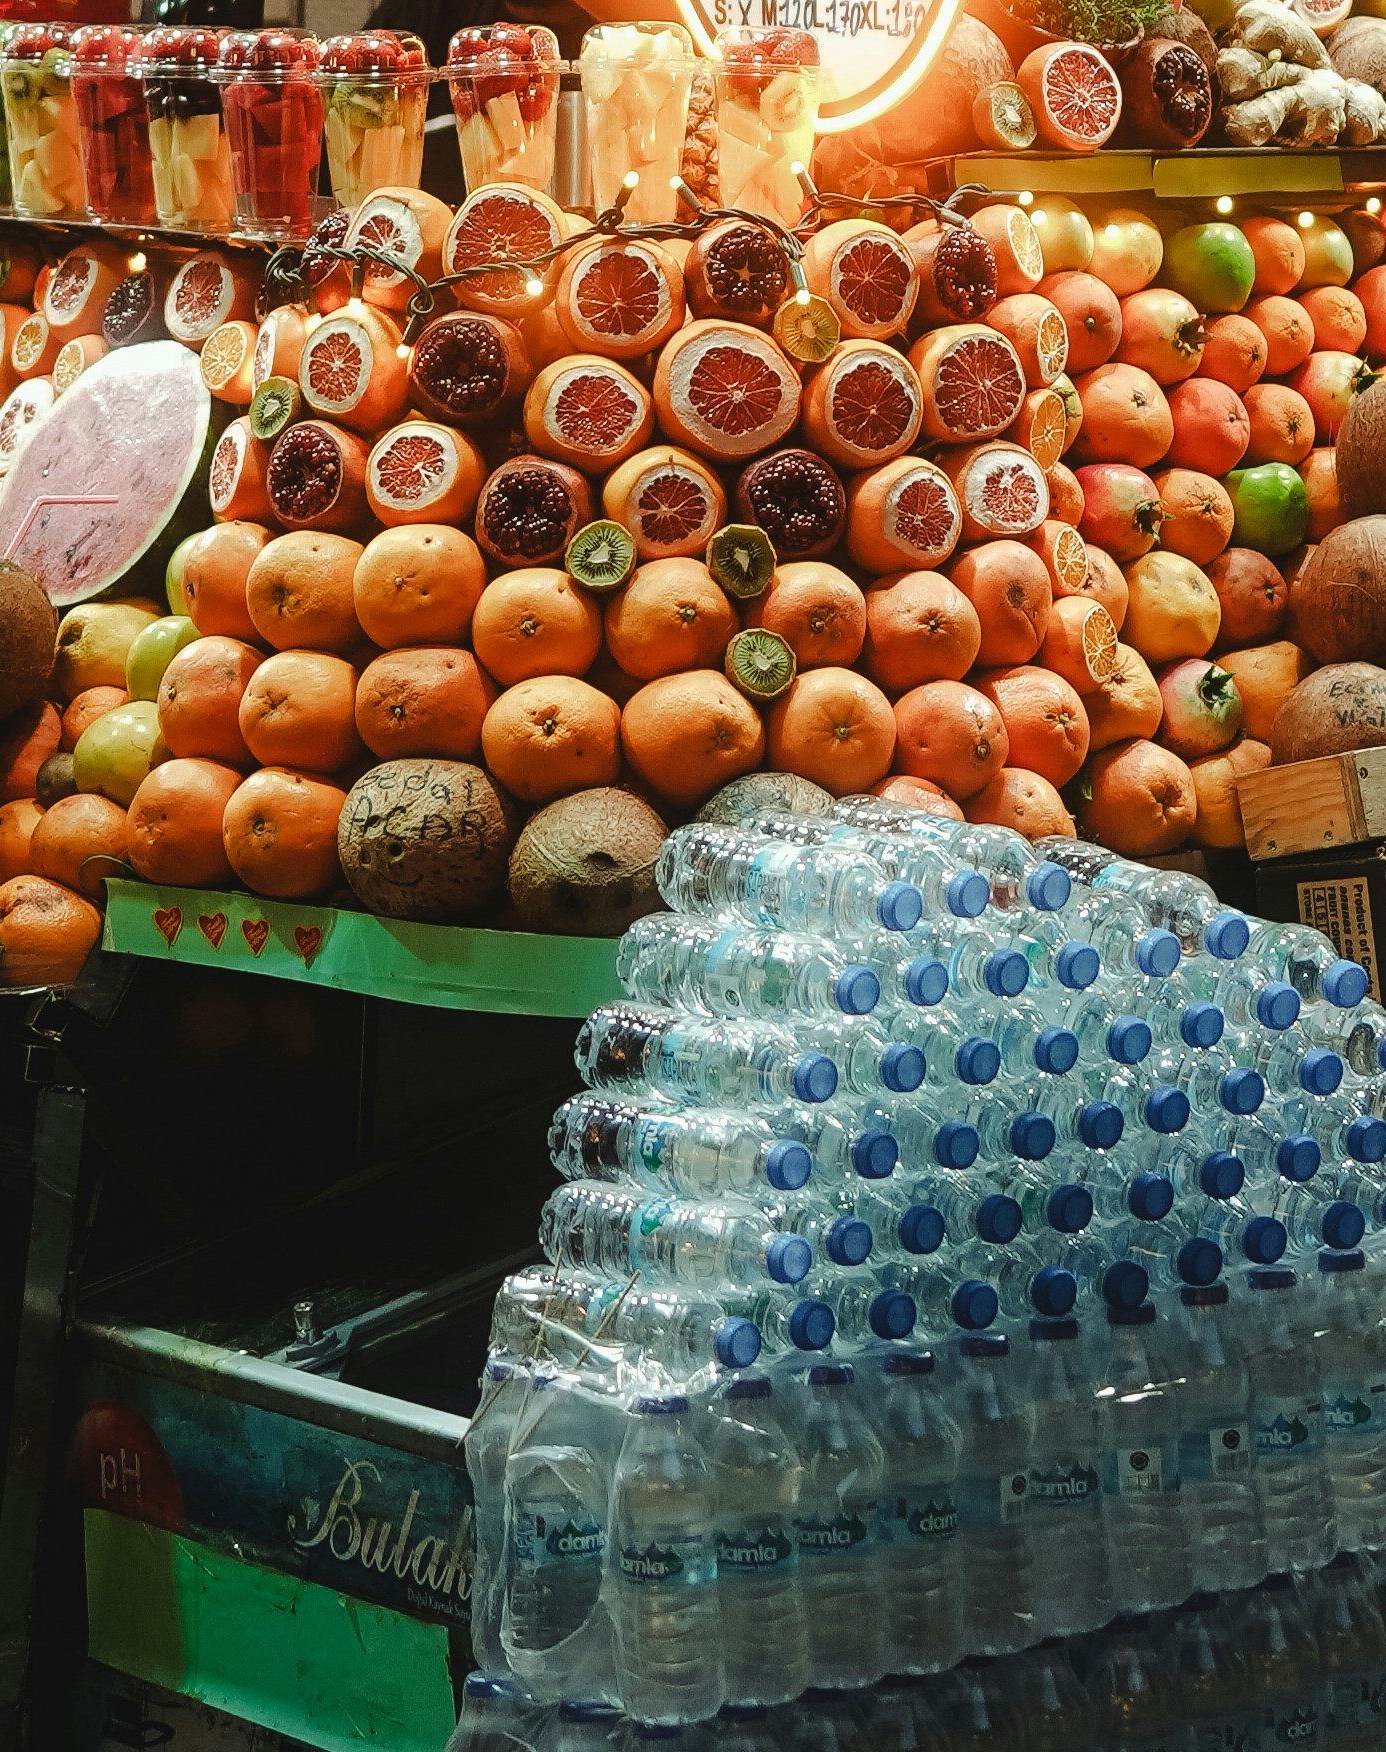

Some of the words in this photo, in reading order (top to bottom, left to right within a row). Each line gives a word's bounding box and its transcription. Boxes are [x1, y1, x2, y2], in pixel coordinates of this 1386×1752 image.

[1326, 886, 1338, 919] FRUIT
[1339, 885, 1353, 933] ananas
[1351, 883, 1368, 931] Product
[1359, 935, 1369, 952] of
[99, 1447, 143, 1503] pH
